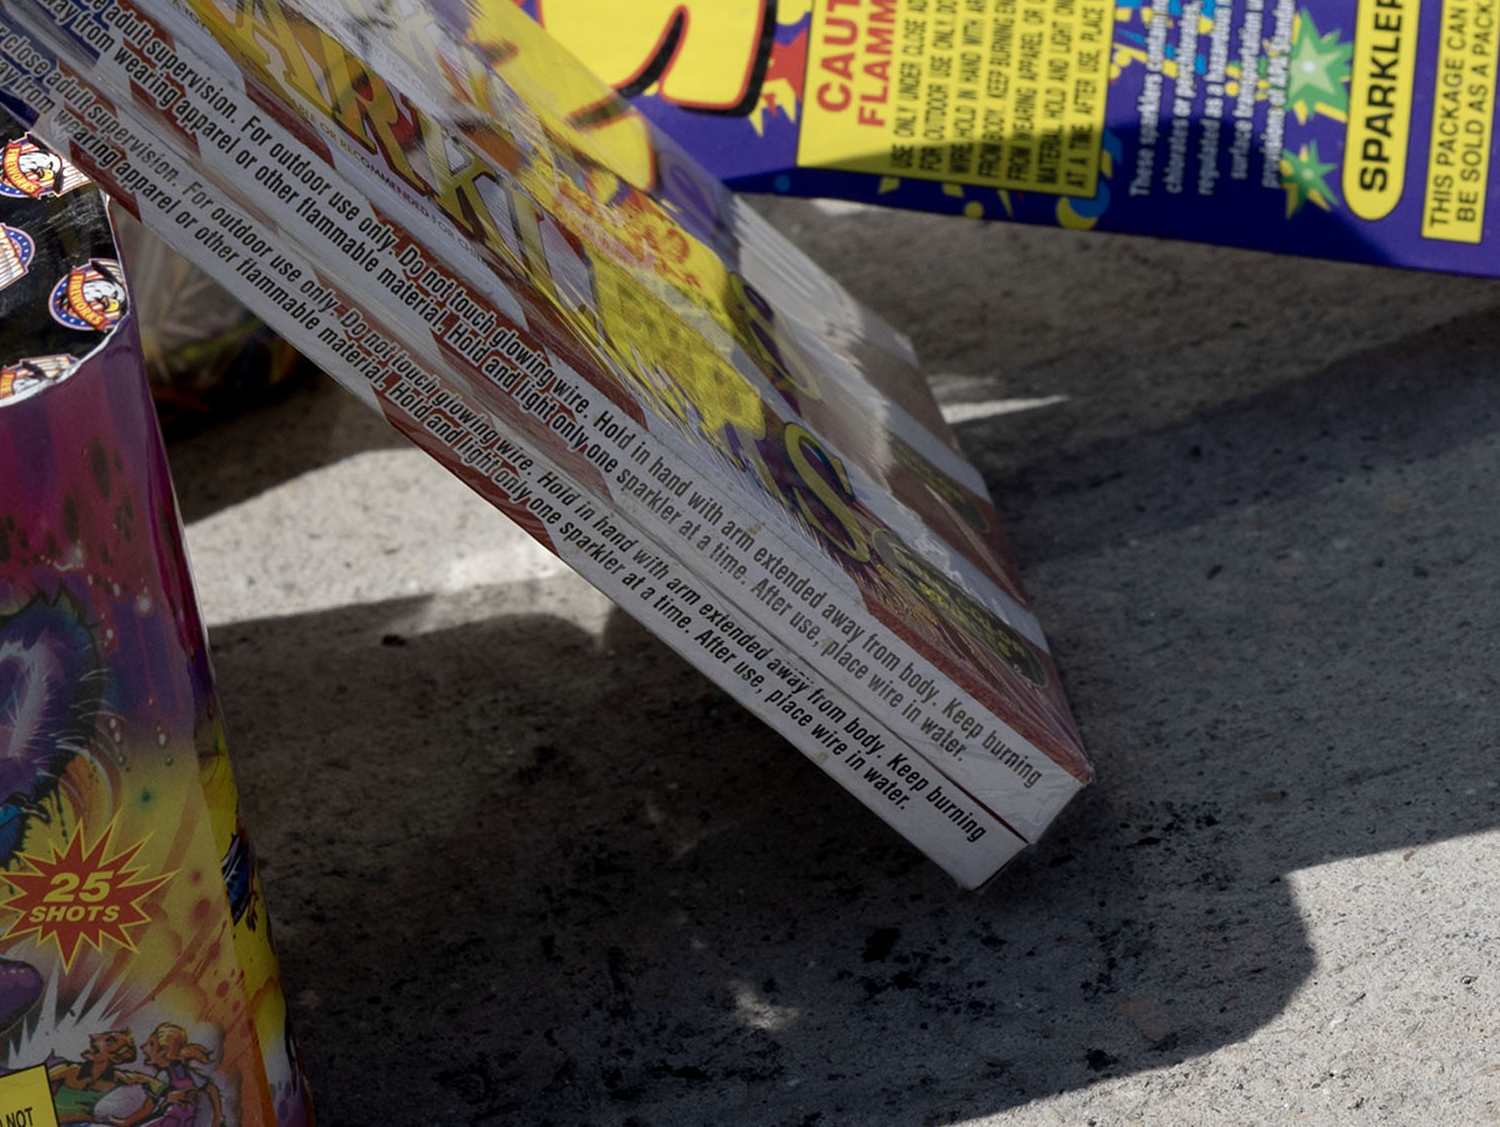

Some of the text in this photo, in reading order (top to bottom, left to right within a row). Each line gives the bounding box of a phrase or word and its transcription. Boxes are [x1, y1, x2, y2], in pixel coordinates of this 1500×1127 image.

[1445, 8, 1468, 50] CAN
[1470, 63, 1489, 77] A
[1436, 57, 1464, 166] PACKAGE
[1467, 83, 1487, 113] AS
[0, 31, 54, 75] close
[44, 67, 95, 109] adult
[82, 102, 188, 189] supervision.
[181, 180, 220, 212] For
[209, 202, 278, 259] outdoor
[1461, 120, 1485, 182] SOLD
[1429, 174, 1453, 228] THIS
[1457, 190, 1477, 222] BE
[72, 11, 120, 51] from
[105, 44, 183, 110] wearing
[168, 95, 243, 158] apparel
[233, 148, 258, 171] or
[252, 161, 304, 205] other
[293, 195, 385, 273] flammable
[374, 263, 456, 332] material.
[446, 322, 493, 363] Hold
[483, 353, 523, 389] and
[508, 378, 561, 424] light
[546, 409, 595, 453] only
[584, 442, 621, 473] one
[611, 463, 685, 528] sparkler
[676, 514, 704, 540] at
[695, 534, 713, 551] a
[707, 540, 758, 585] time.
[750, 576, 797, 617] After
[784, 611, 827, 649] use,
[819, 636, 873, 684] place
[864, 672, 907, 710] wire
[899, 701, 924, 724] in
[916, 713, 973, 764] water.
[102, 2, 155, 47] adult
[138, 37, 247, 128] supervision.
[238, 115, 276, 148] For
[266, 138, 336, 198] outdoor
[325, 192, 361, 222] use
[351, 213, 407, 261] only.
[396, 247, 431, 277] Do
[419, 266, 457, 299] not
[445, 288, 500, 335] touch
[485, 324, 560, 389] glowing
[549, 376, 599, 419] wire.
[591, 409, 638, 450] Hold
[629, 441, 655, 466] in
[647, 455, 694, 496] hand
[685, 487, 728, 525] with
[720, 519, 756, 552] arm
[751, 542, 829, 609] extended
[816, 602, 865, 645] away
[859, 631, 905, 672] from
[894, 662, 948, 710] body.
[937, 697, 988, 743] Keep
[977, 730, 1045, 791] burning
[43, 870, 114, 903] 25
[28, 905, 121, 923] SHOTS
[5, 1106, 34, 1127] NOT
